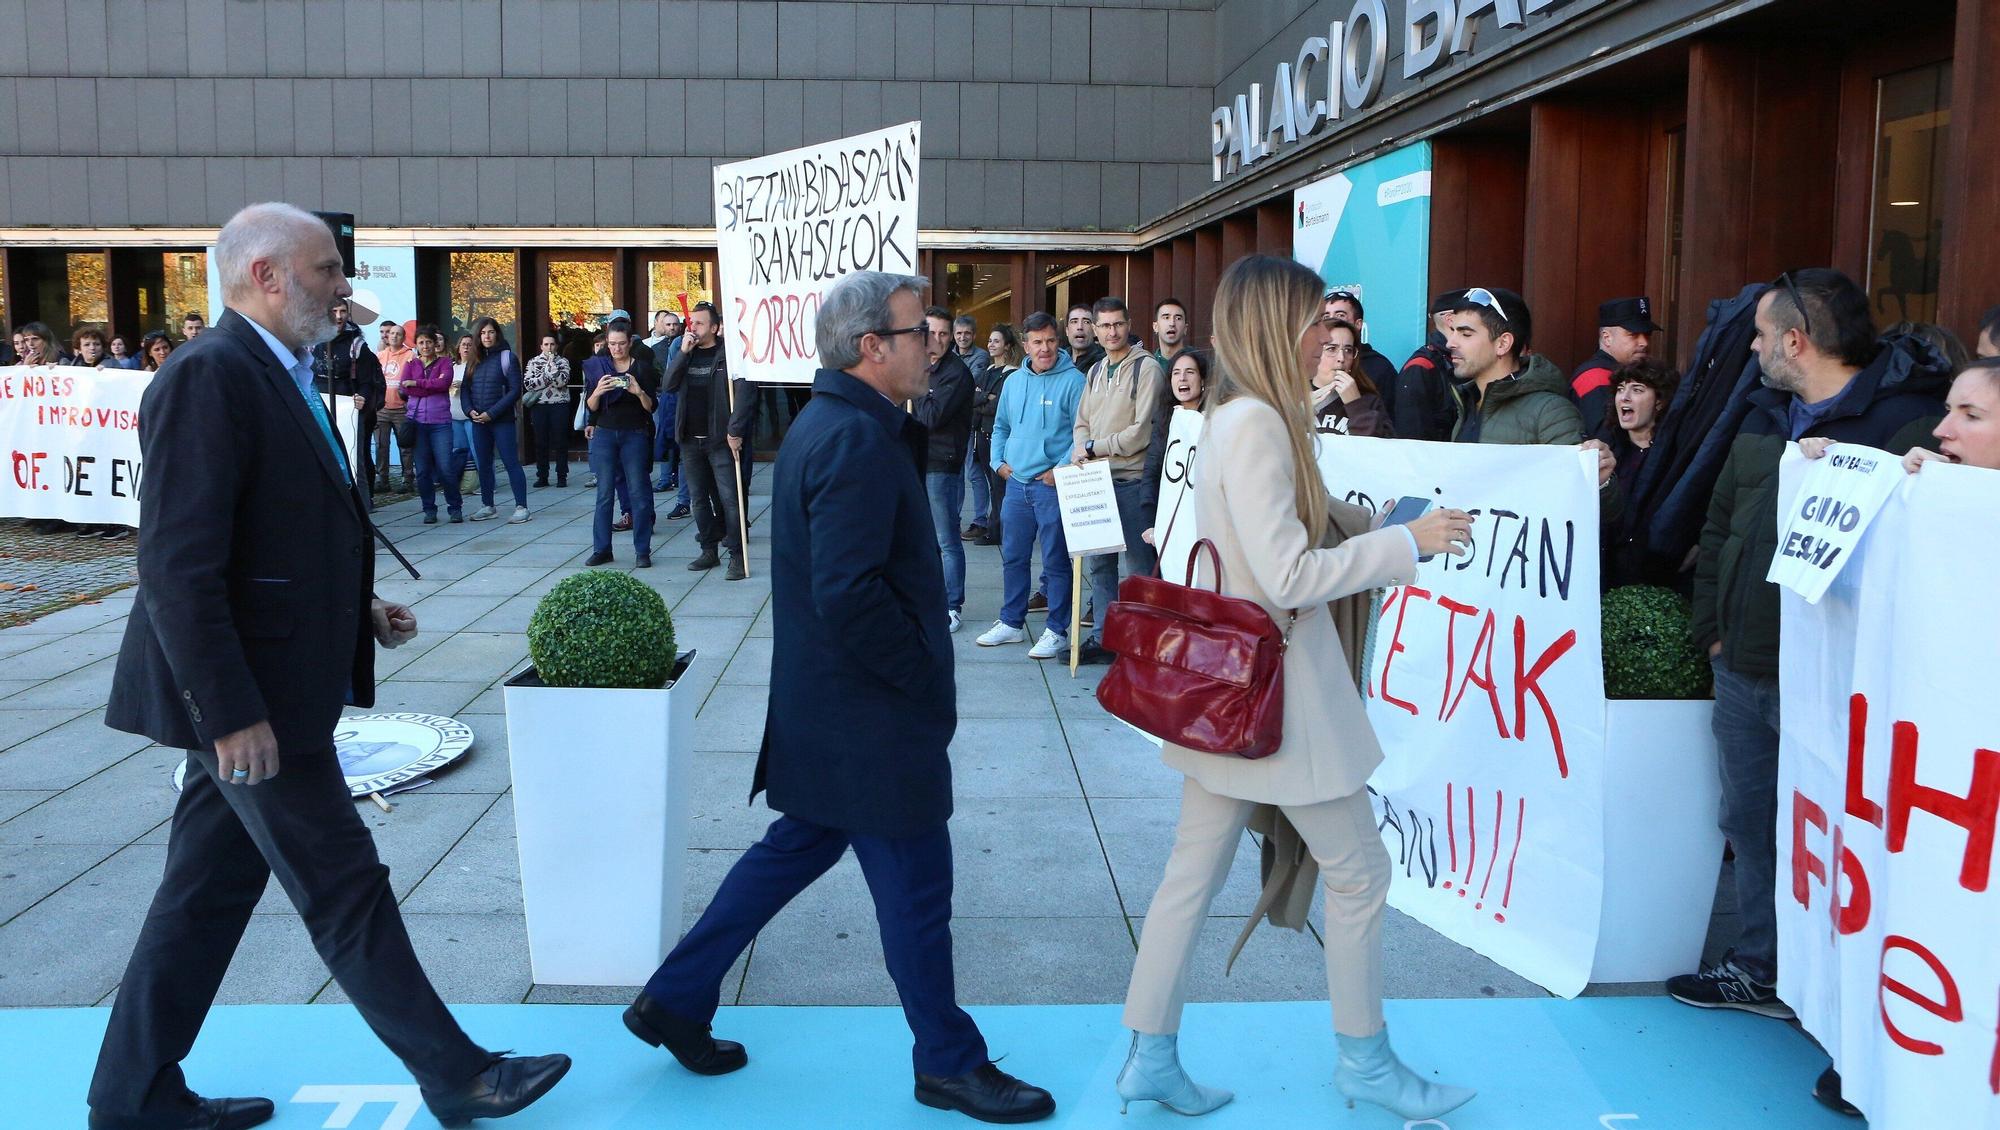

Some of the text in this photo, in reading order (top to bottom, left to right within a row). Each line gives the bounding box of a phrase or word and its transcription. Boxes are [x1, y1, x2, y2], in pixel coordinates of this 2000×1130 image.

[1211, 0, 1388, 182] PALACIO
[735, 290, 825, 365] BORRO
[23, 376, 46, 398] NO
[51, 376, 74, 396] ES
[63, 455, 96, 496] DE
[112, 458, 142, 501] EV
